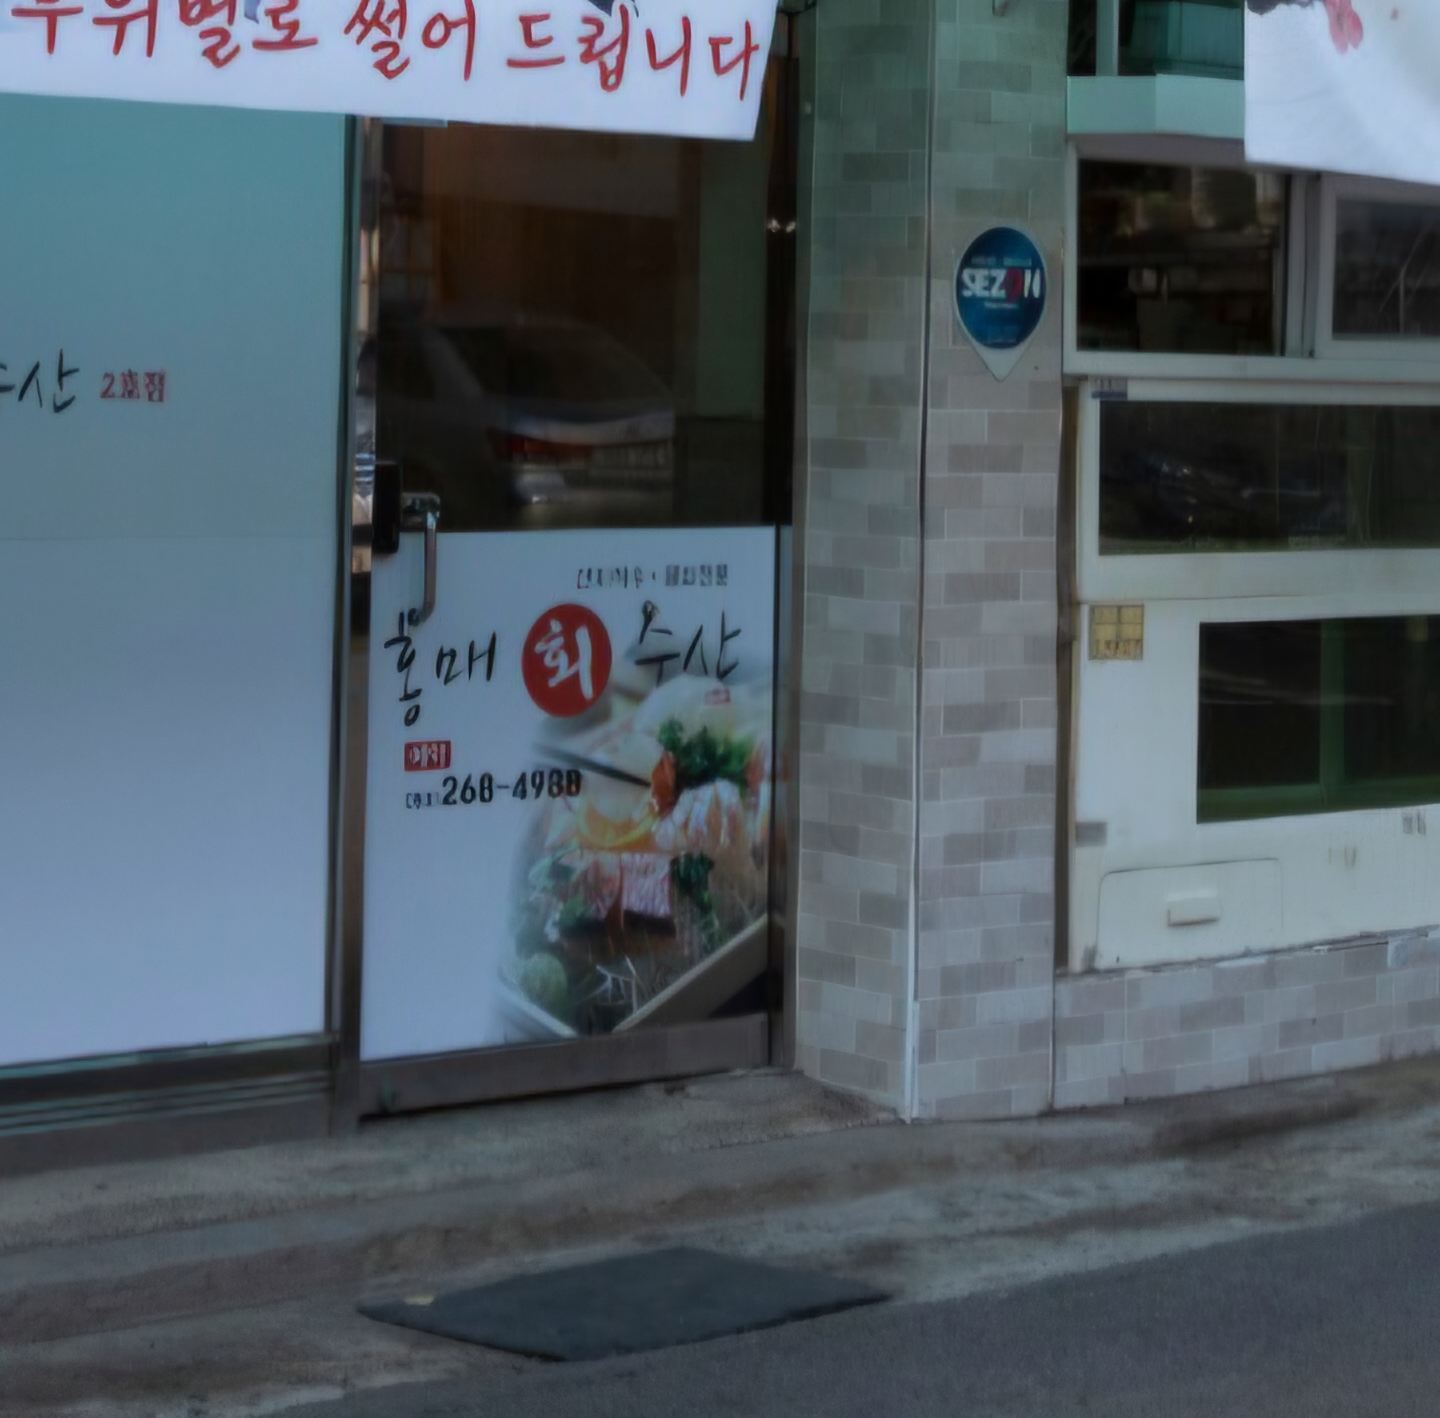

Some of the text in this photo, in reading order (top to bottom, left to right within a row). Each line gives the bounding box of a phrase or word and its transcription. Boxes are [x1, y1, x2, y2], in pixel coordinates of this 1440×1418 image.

[503, 9, 761, 104] 드립니다
[383, 610, 498, 727] 홍매
[633, 599, 743, 689] 수산
[441, 767, 583, 807] 268-4988
